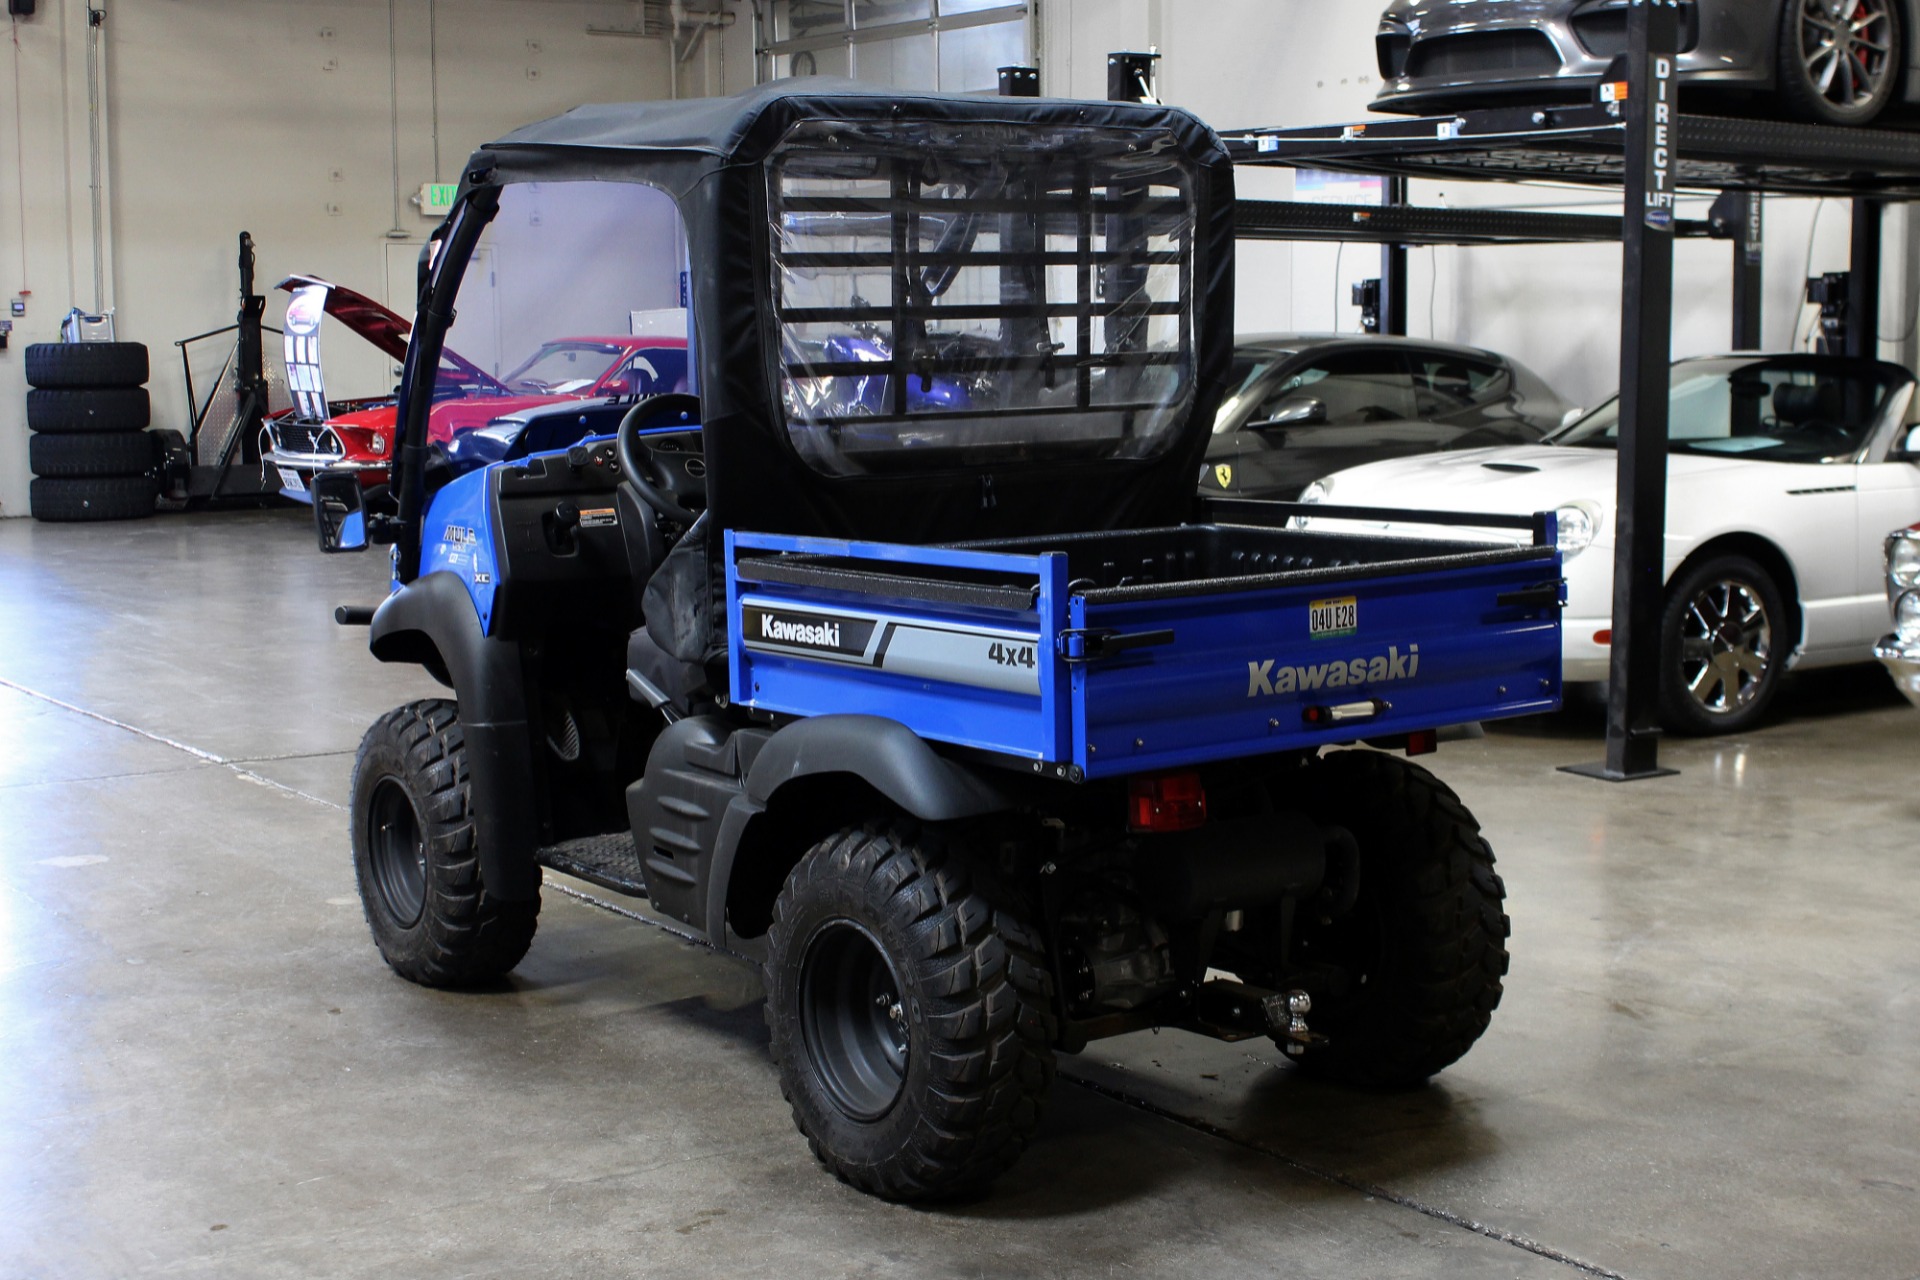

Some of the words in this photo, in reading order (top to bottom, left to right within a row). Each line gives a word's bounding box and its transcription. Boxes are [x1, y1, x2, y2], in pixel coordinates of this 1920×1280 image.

[1653, 58, 1671, 191] DIRECT
[1645, 191, 1673, 208] LIFT
[443, 525, 477, 545] MULE
[475, 572, 490, 584] XC
[761, 613, 840, 648] Kawasaki
[1312, 607, 1332, 632] 04U
[1335, 604, 1355, 629] E28
[988, 642, 1036, 669] 4x4
[1247, 643, 1419, 698] Kawasaki
